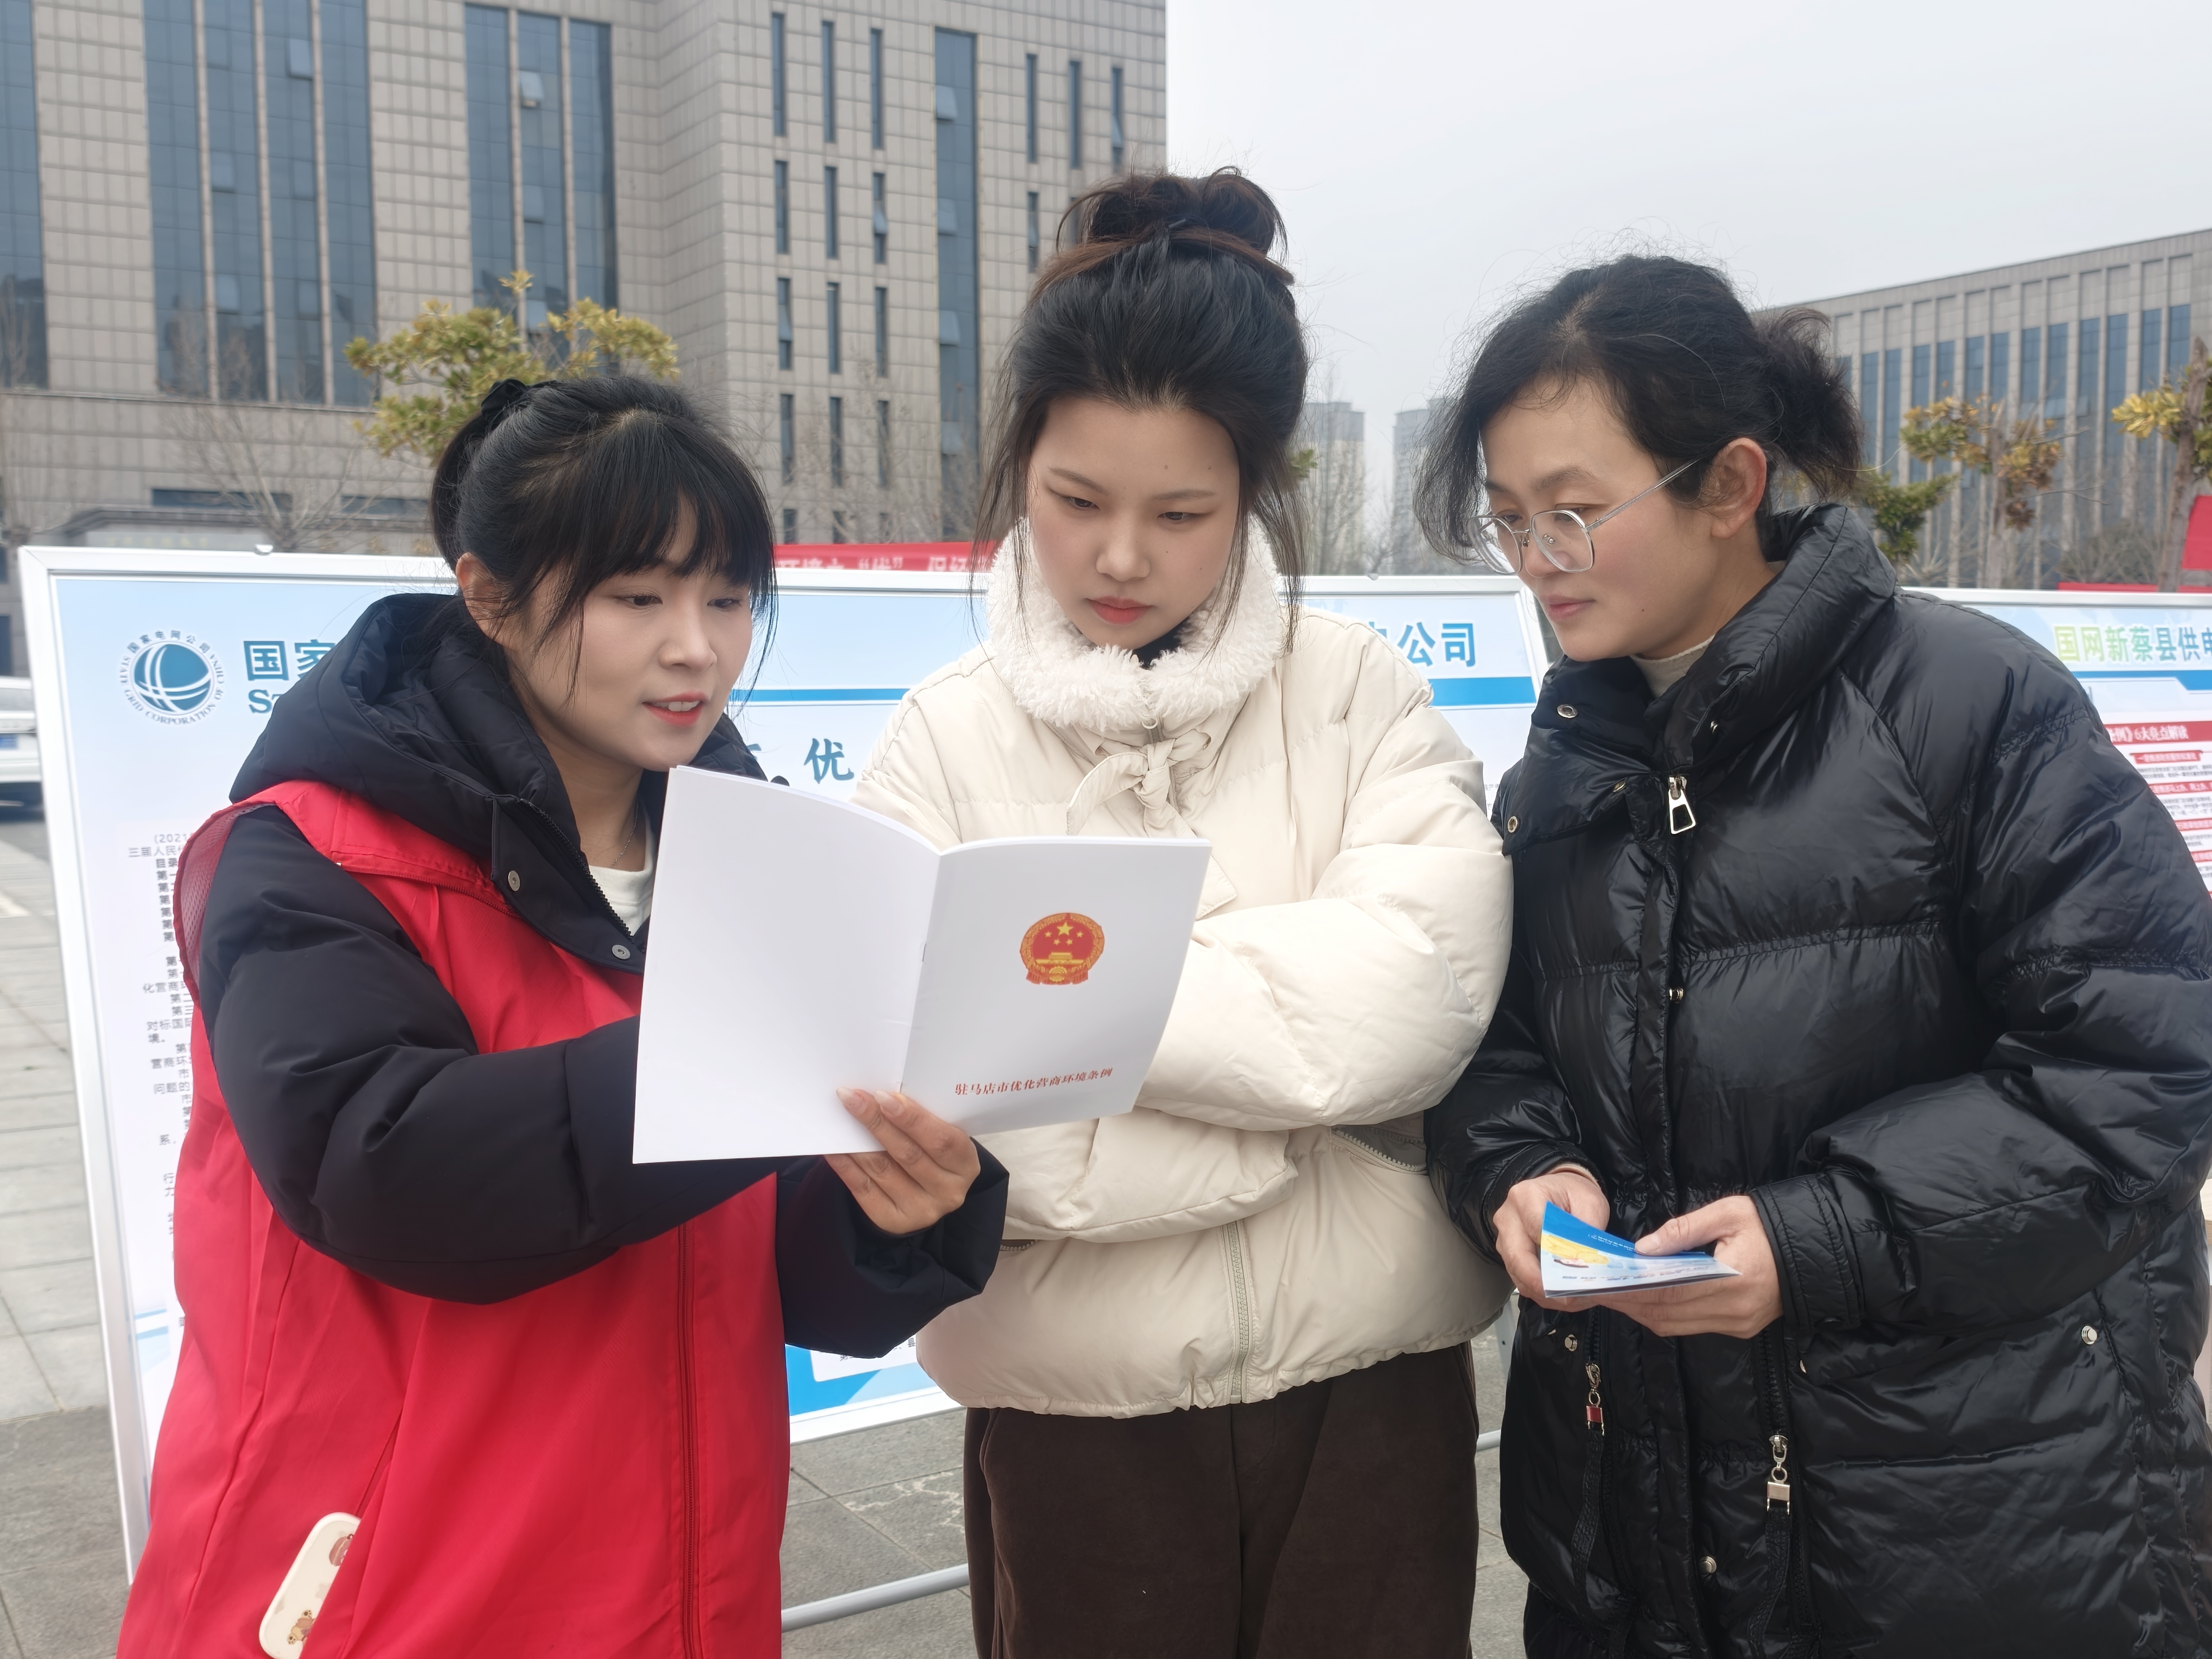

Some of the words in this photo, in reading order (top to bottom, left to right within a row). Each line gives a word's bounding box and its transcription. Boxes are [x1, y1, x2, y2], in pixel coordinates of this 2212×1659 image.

[127, 630, 210, 654] 国家电网公司
[1369, 622, 1476, 667] 公司
[243, 639, 336, 681] 国家
[145, 701, 216, 725] CORPORATION
[804, 738, 854, 784] 优
[151, 1056, 192, 1069] 营商环
[955, 1068, 1113, 1095] 驻马店市优化营商环境条例
